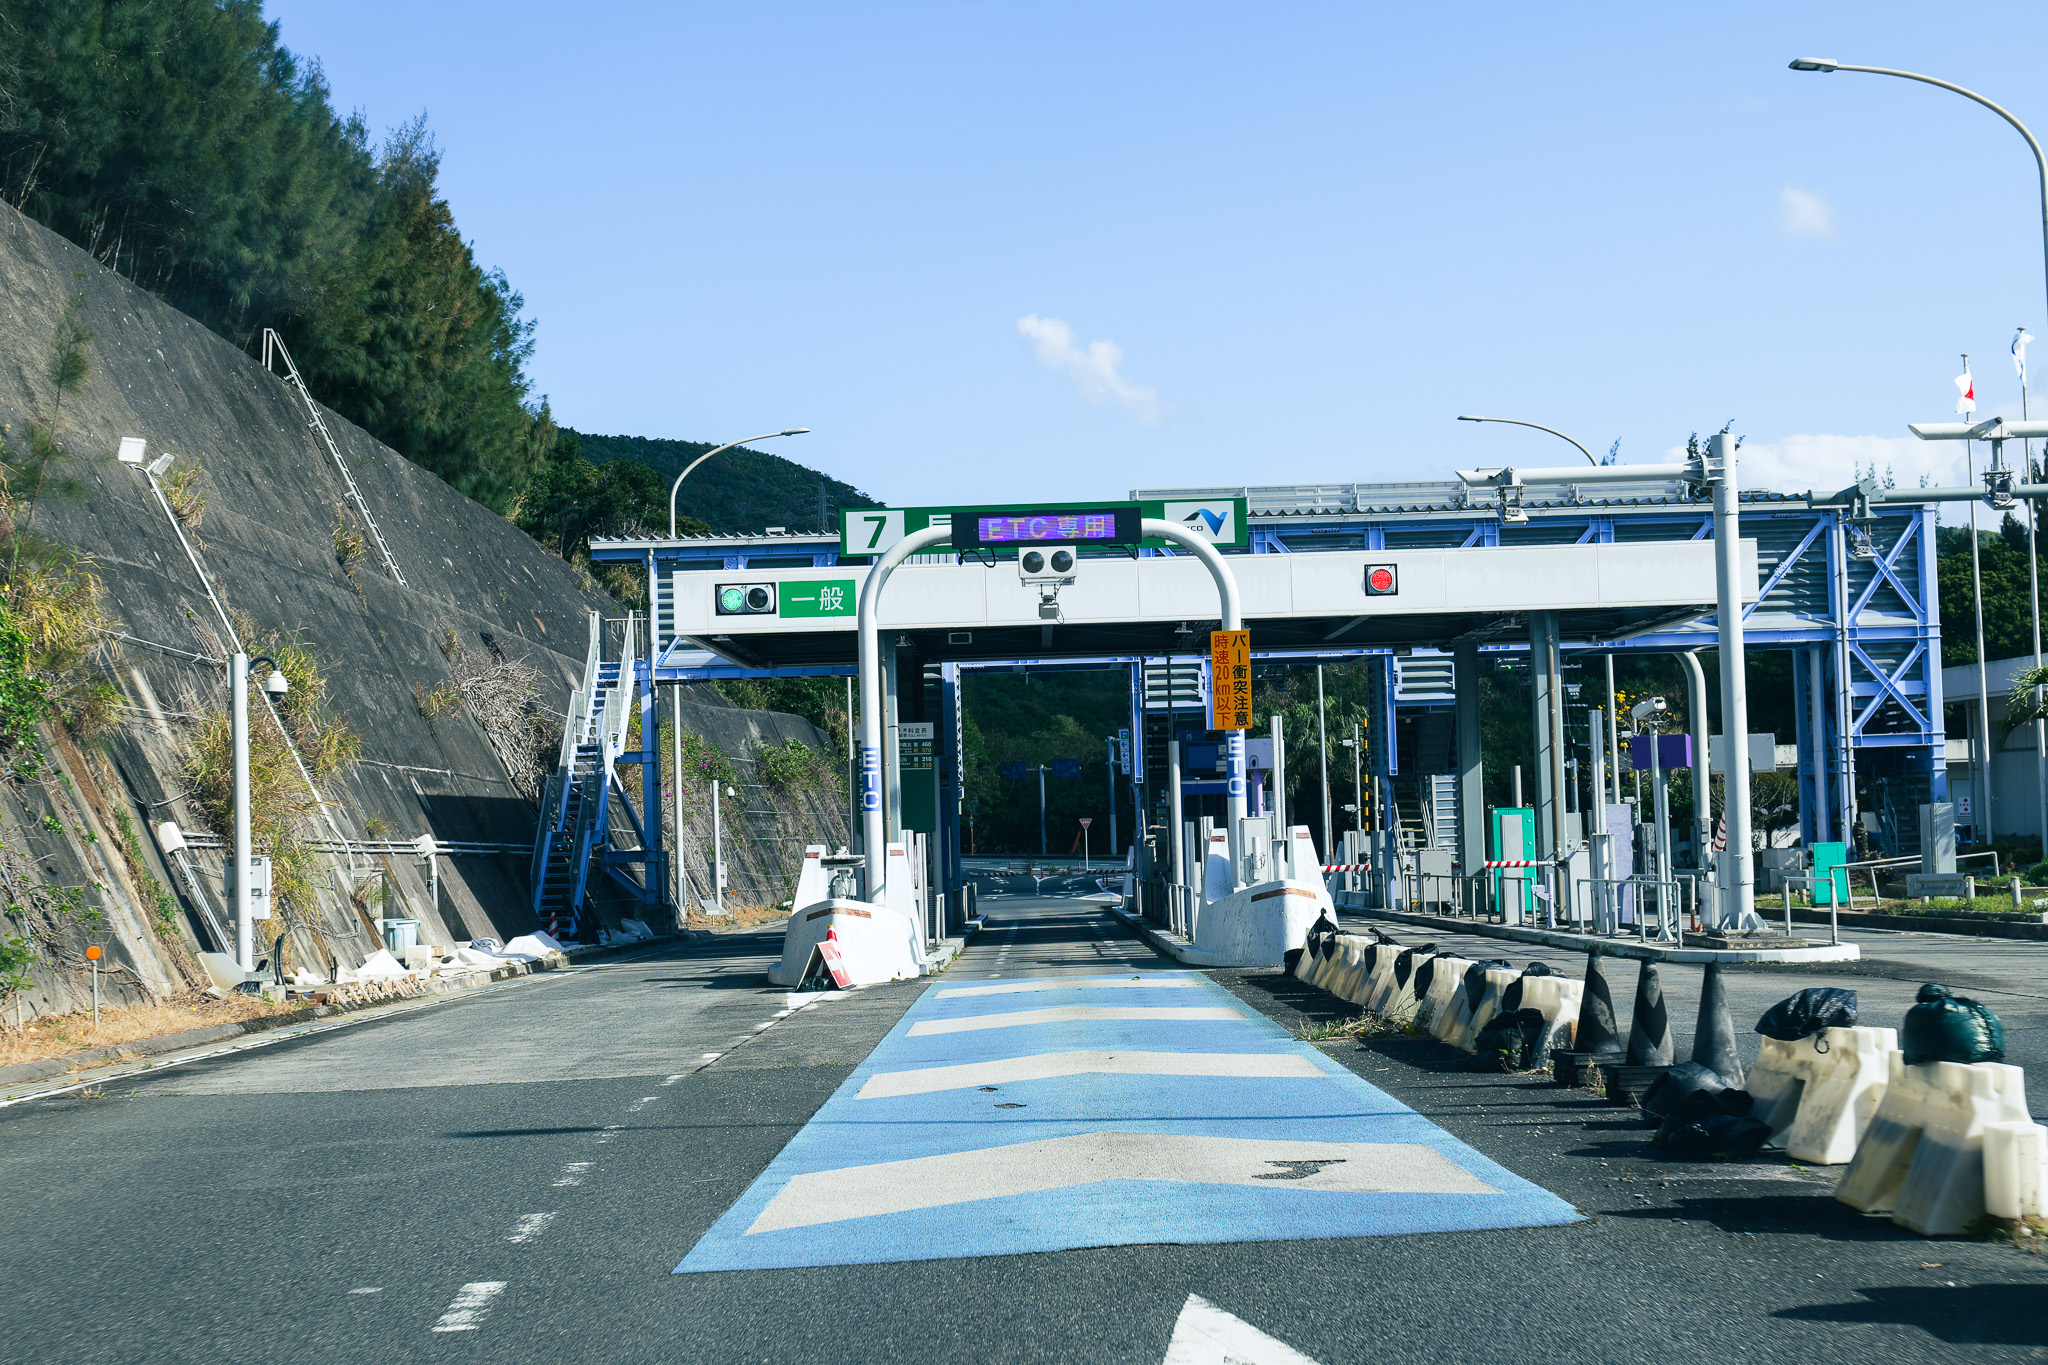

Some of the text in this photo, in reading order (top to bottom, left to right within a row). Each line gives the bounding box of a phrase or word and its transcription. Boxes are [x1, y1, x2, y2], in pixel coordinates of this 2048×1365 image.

[863, 515, 887, 549] 7
[791, 586, 844, 611] 一般
[1214, 635, 1231, 727] 時速20km以下
[1232, 634, 1249, 727] バー衝突注意
[862, 750, 880, 808] ETC
[1228, 737, 1245, 795] ETC
